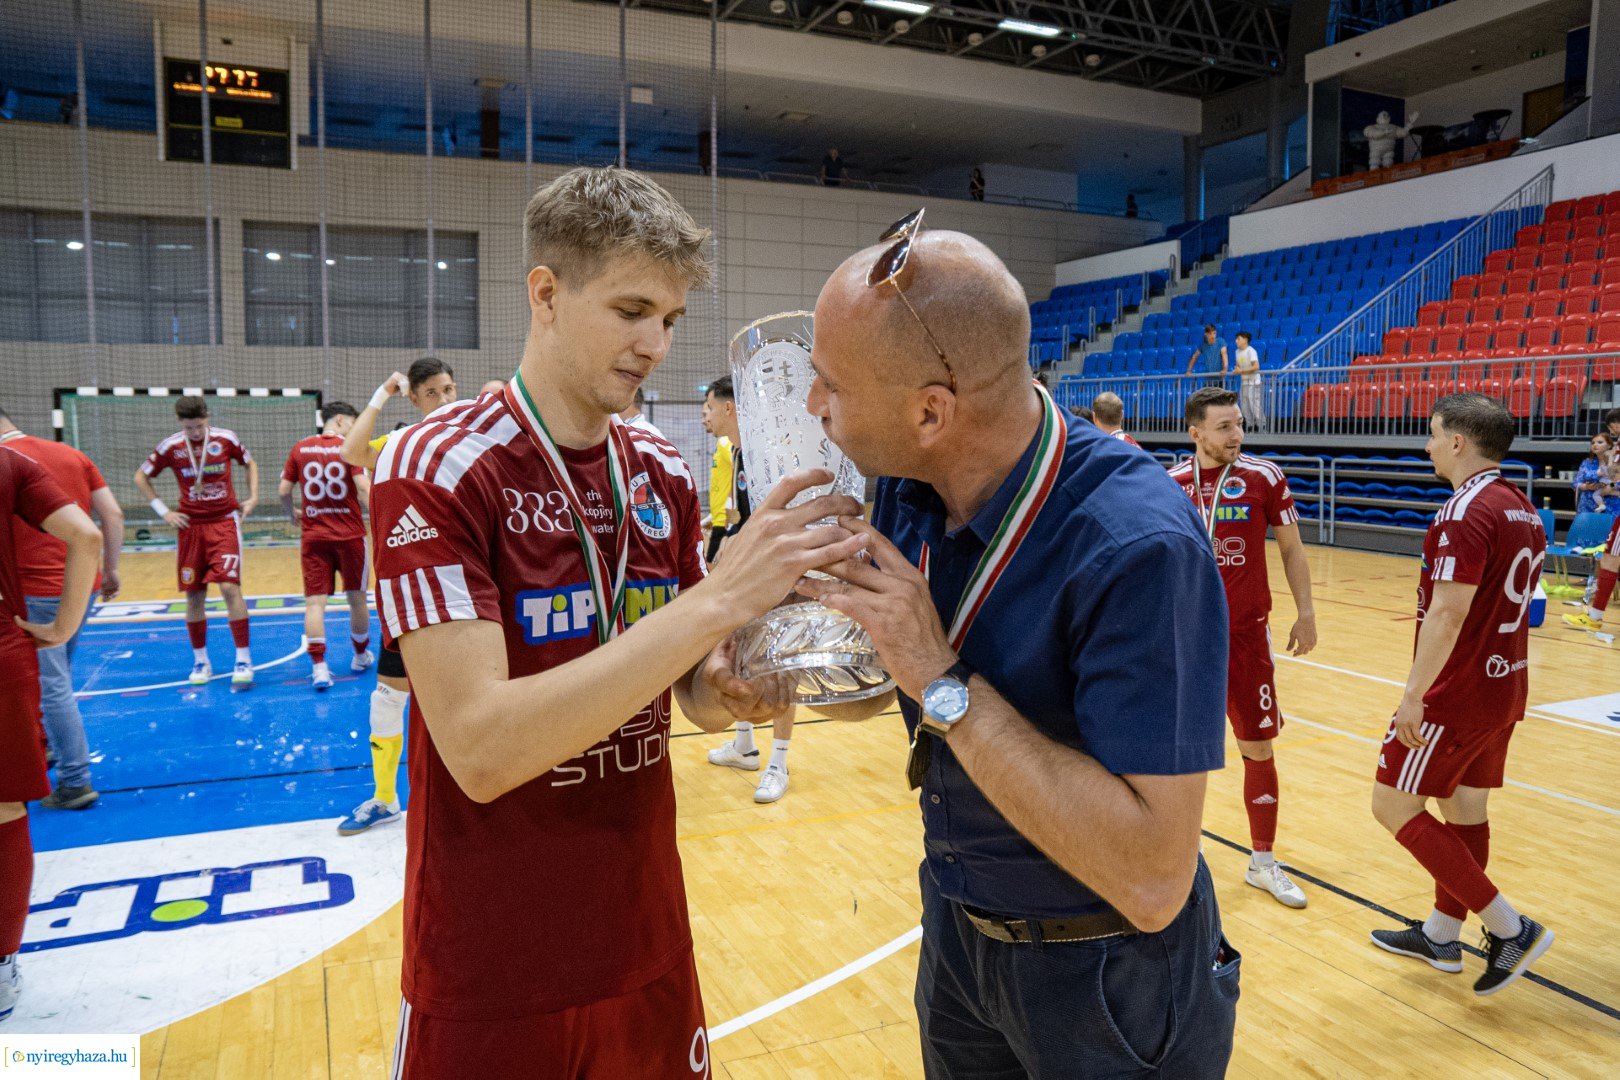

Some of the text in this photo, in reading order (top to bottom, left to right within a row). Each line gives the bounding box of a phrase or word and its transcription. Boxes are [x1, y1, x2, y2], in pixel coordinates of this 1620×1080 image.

[303, 461, 347, 501] 88
[386, 526, 439, 548] adidas
[221, 554, 239, 570] 77
[1259, 683, 1272, 711] 8
[551, 728, 671, 787] STUDI
